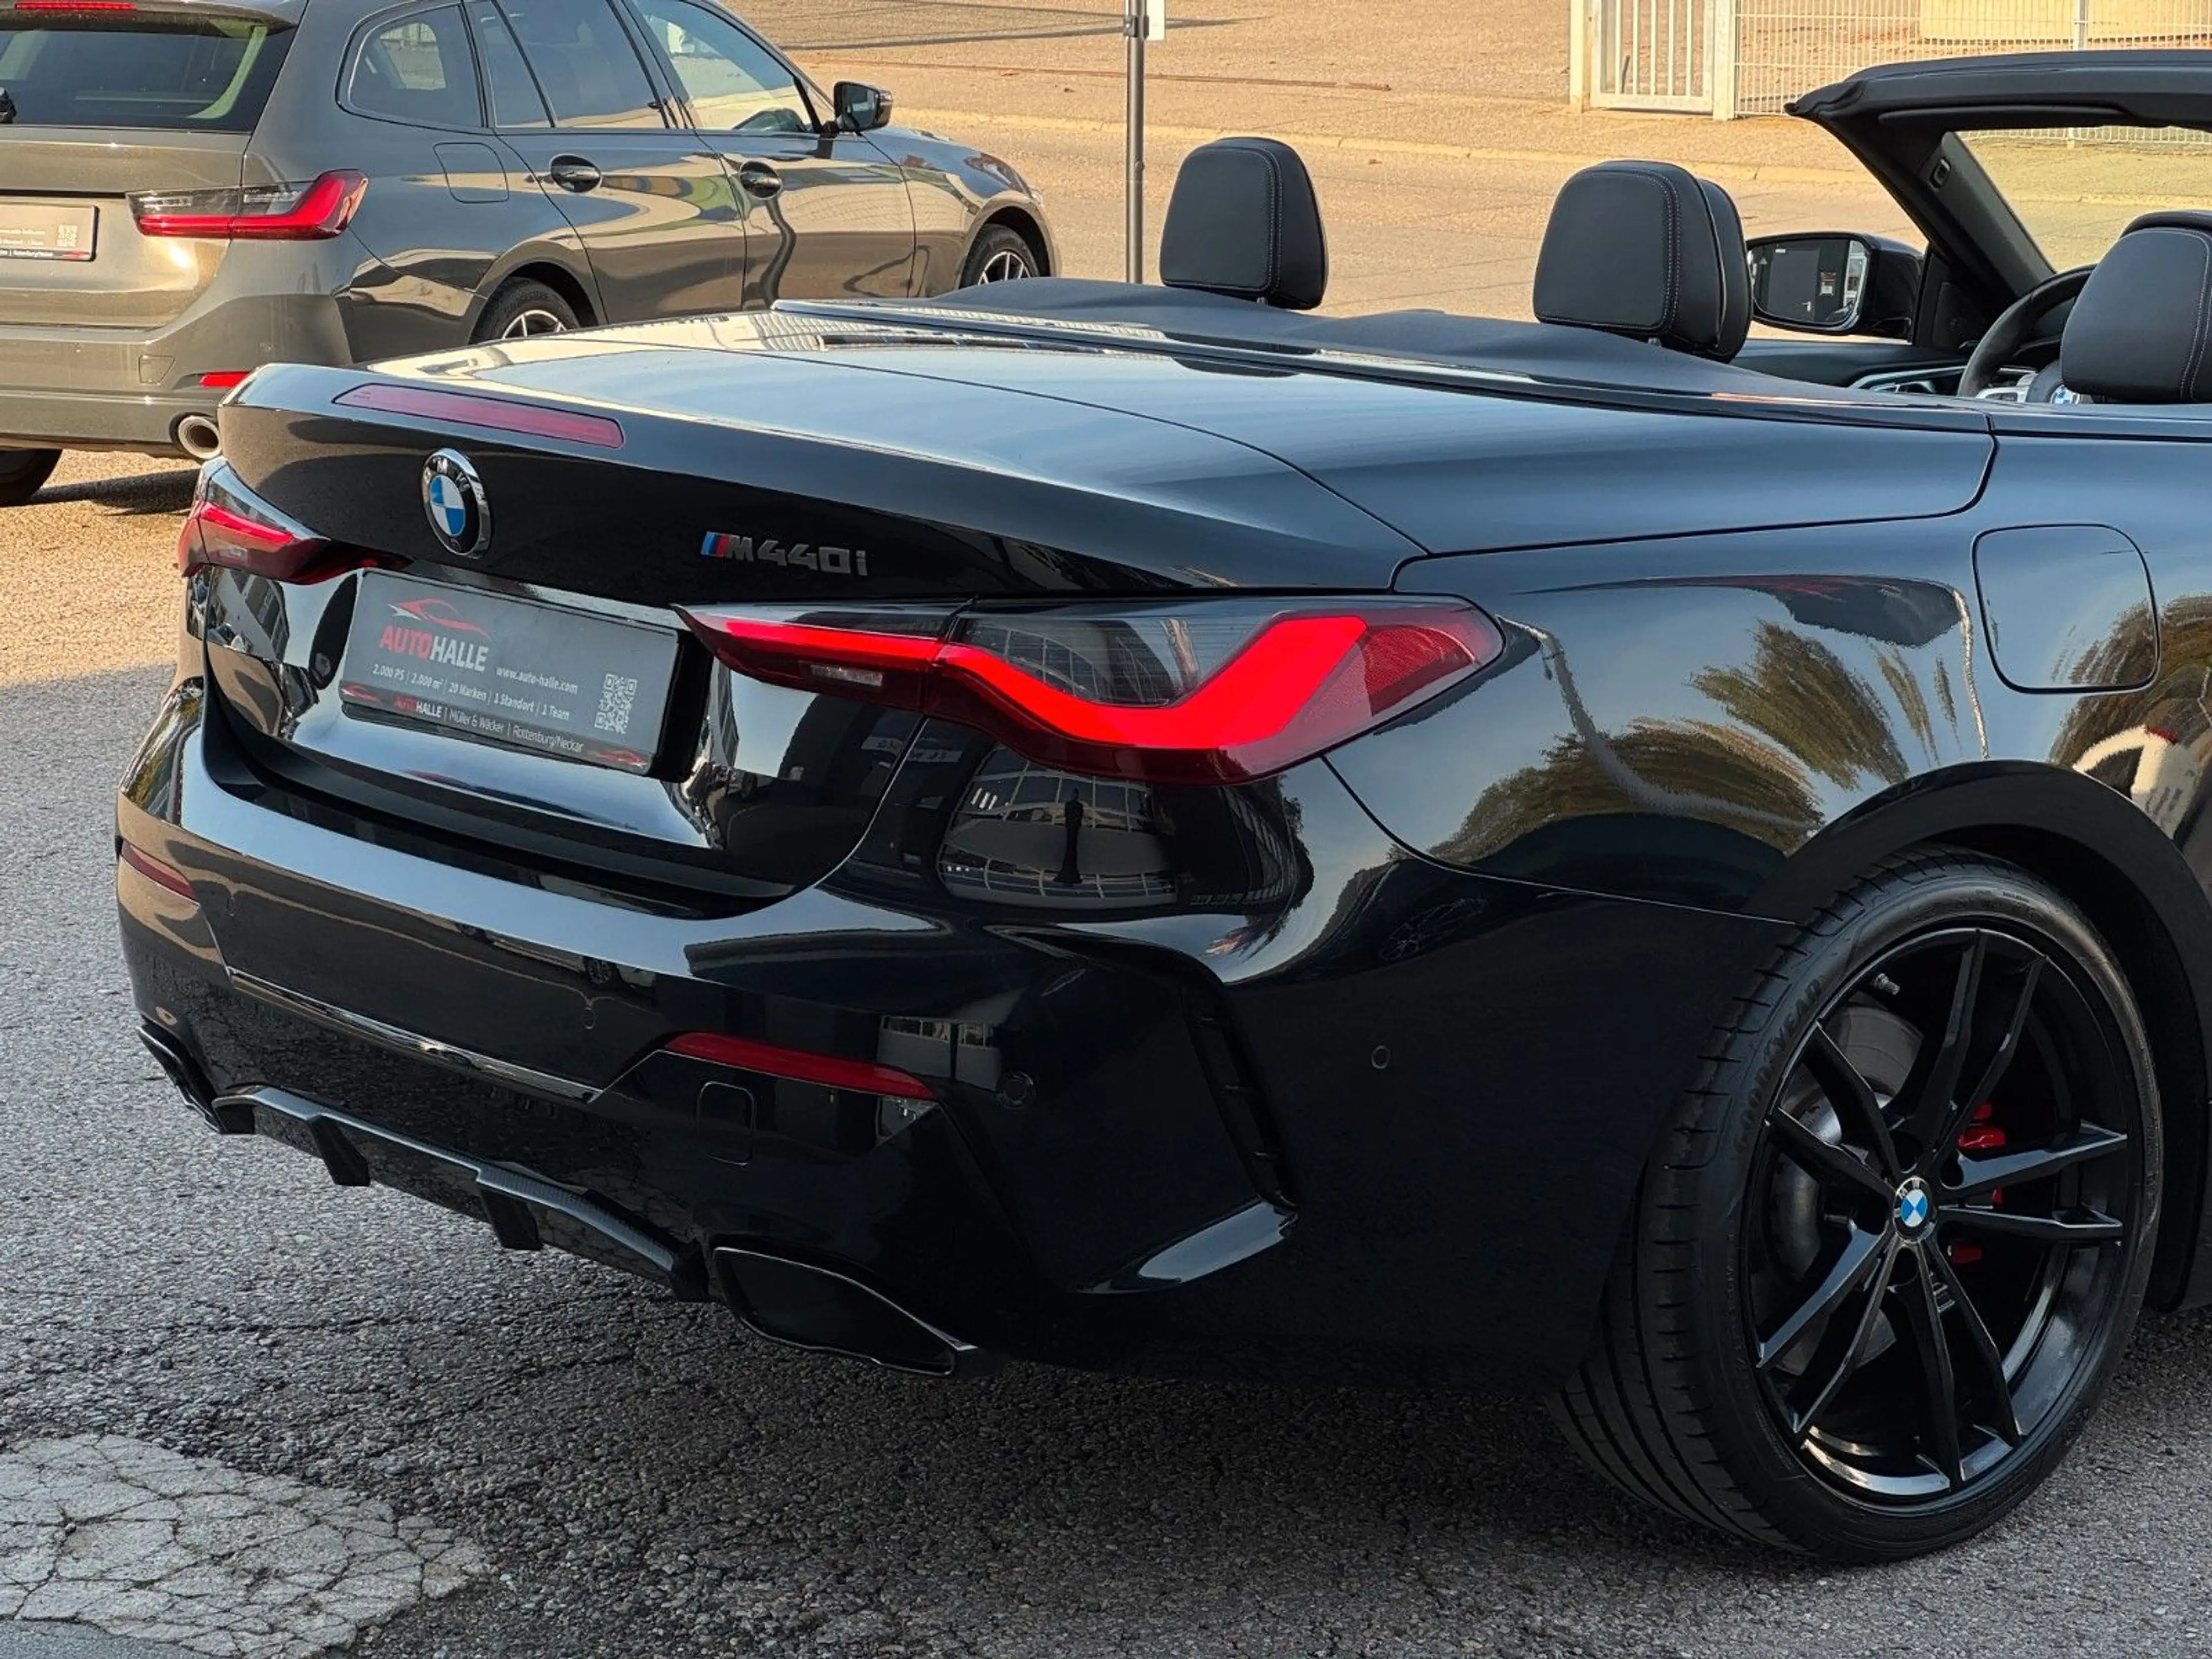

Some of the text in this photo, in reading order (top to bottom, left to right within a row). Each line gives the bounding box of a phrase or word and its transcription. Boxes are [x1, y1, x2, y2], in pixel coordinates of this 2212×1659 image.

[720, 532, 868, 577] M440i
[379, 624, 489, 672] AUTOHALLE
[373, 664, 393, 678] 2.000
[394, 668, 405, 681] PS
[459, 684, 487, 701] Marken
[500, 694, 535, 713] Standort
[549, 705, 570, 721] Team
[496, 666, 578, 694] www.auto-halle.com
